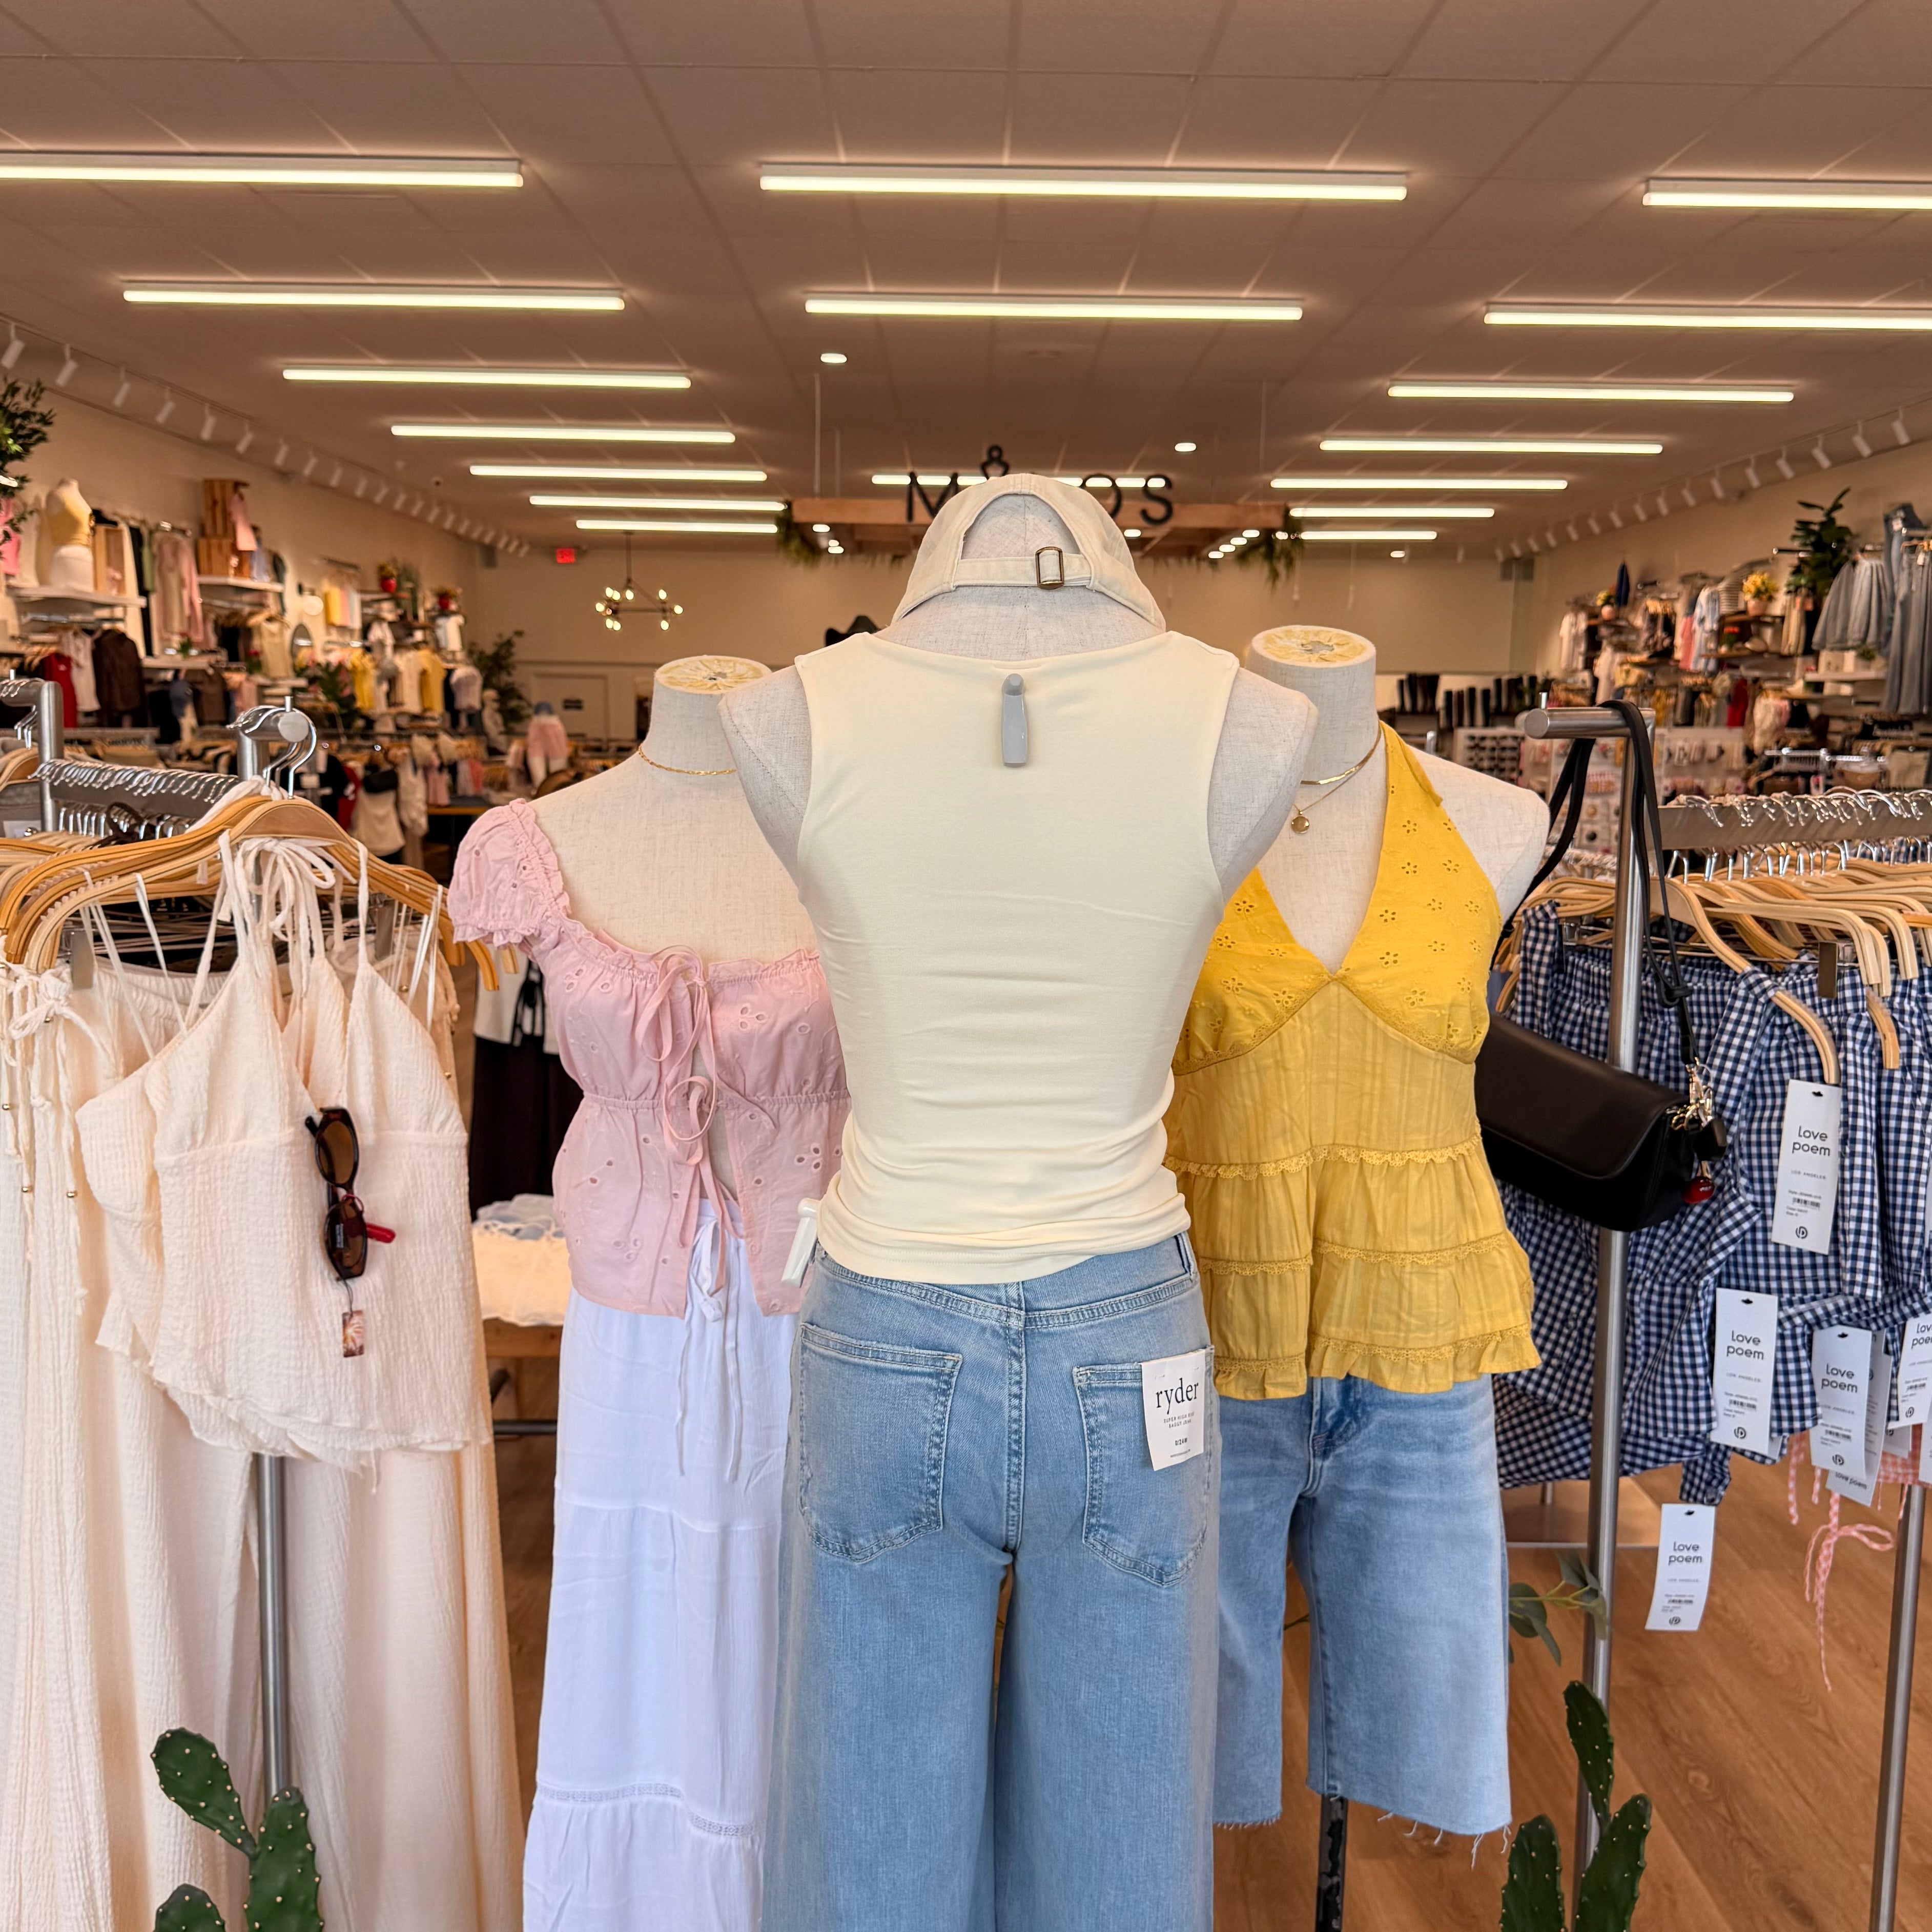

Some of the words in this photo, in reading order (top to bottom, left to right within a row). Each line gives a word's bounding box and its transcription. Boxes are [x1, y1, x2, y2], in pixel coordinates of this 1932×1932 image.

[1792, 1142, 1831, 1157] poem
[1917, 1323, 1932, 1333] Lov
[1911, 1335, 1932, 1349] poe
[1727, 1345, 1764, 1360] poem
[1821, 1378, 1858, 1393] poem
[1156, 1378, 1199, 1415] ryder
[1668, 1554, 1702, 1566] poem
